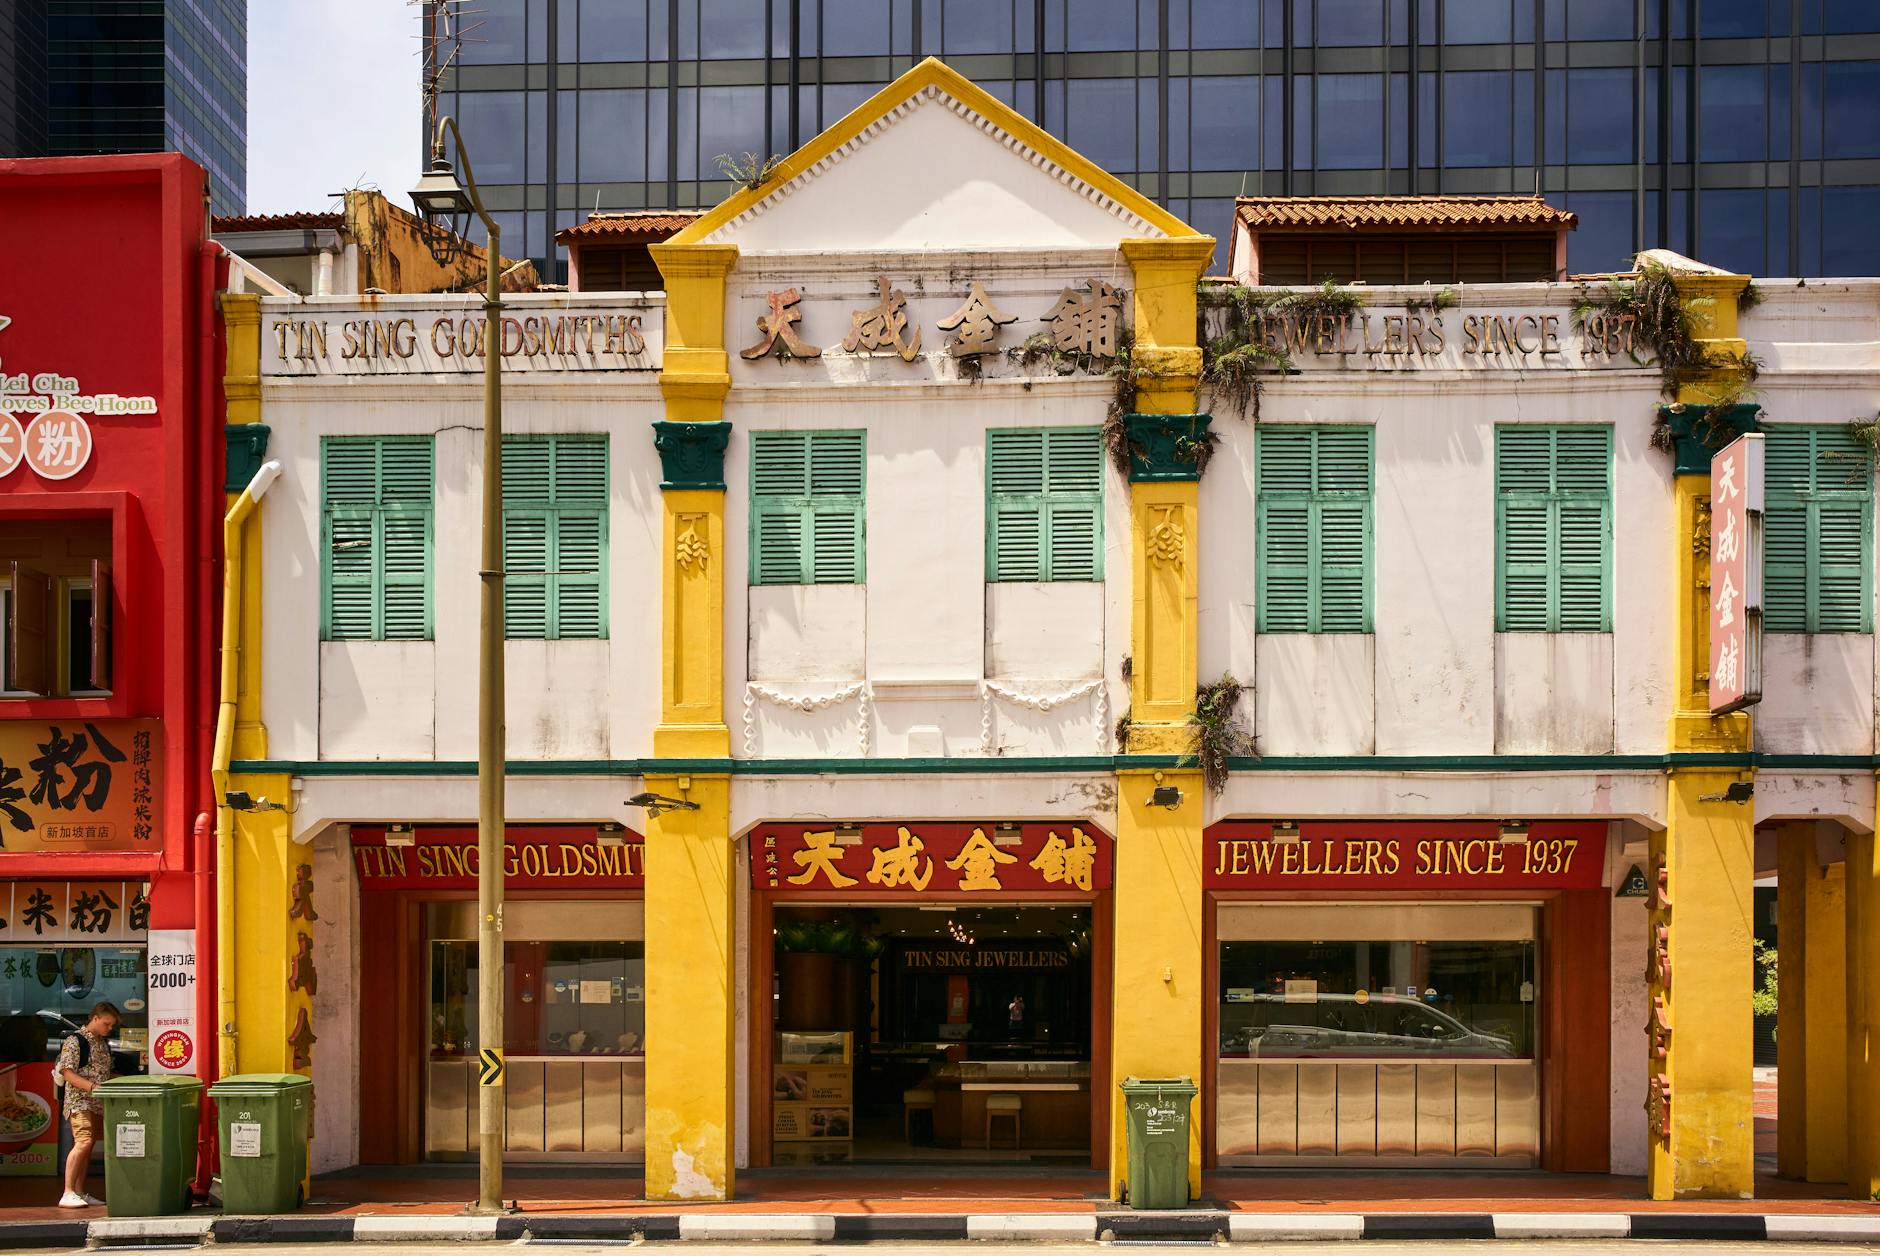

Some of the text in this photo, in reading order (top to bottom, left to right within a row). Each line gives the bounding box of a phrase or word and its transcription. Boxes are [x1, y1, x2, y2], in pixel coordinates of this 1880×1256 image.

[273, 320, 328, 360] TIN
[341, 319, 416, 359] SING
[1464, 314, 1560, 354] SINCE
[1580, 314, 1638, 354] 1937
[35, 376, 76, 391] Cha
[0, 395, 153, 412] oves Bee Hoon
[46, 826, 110, 839] 新加坡首店
[355, 845, 407, 878] TIN
[1215, 839, 1578, 876] JEWELLERS SINCE 1937
[150, 954, 196, 967] 全球门店
[905, 950, 1068, 967] TIN SING JEWELLERS
[150, 972, 196, 989] 2000+
